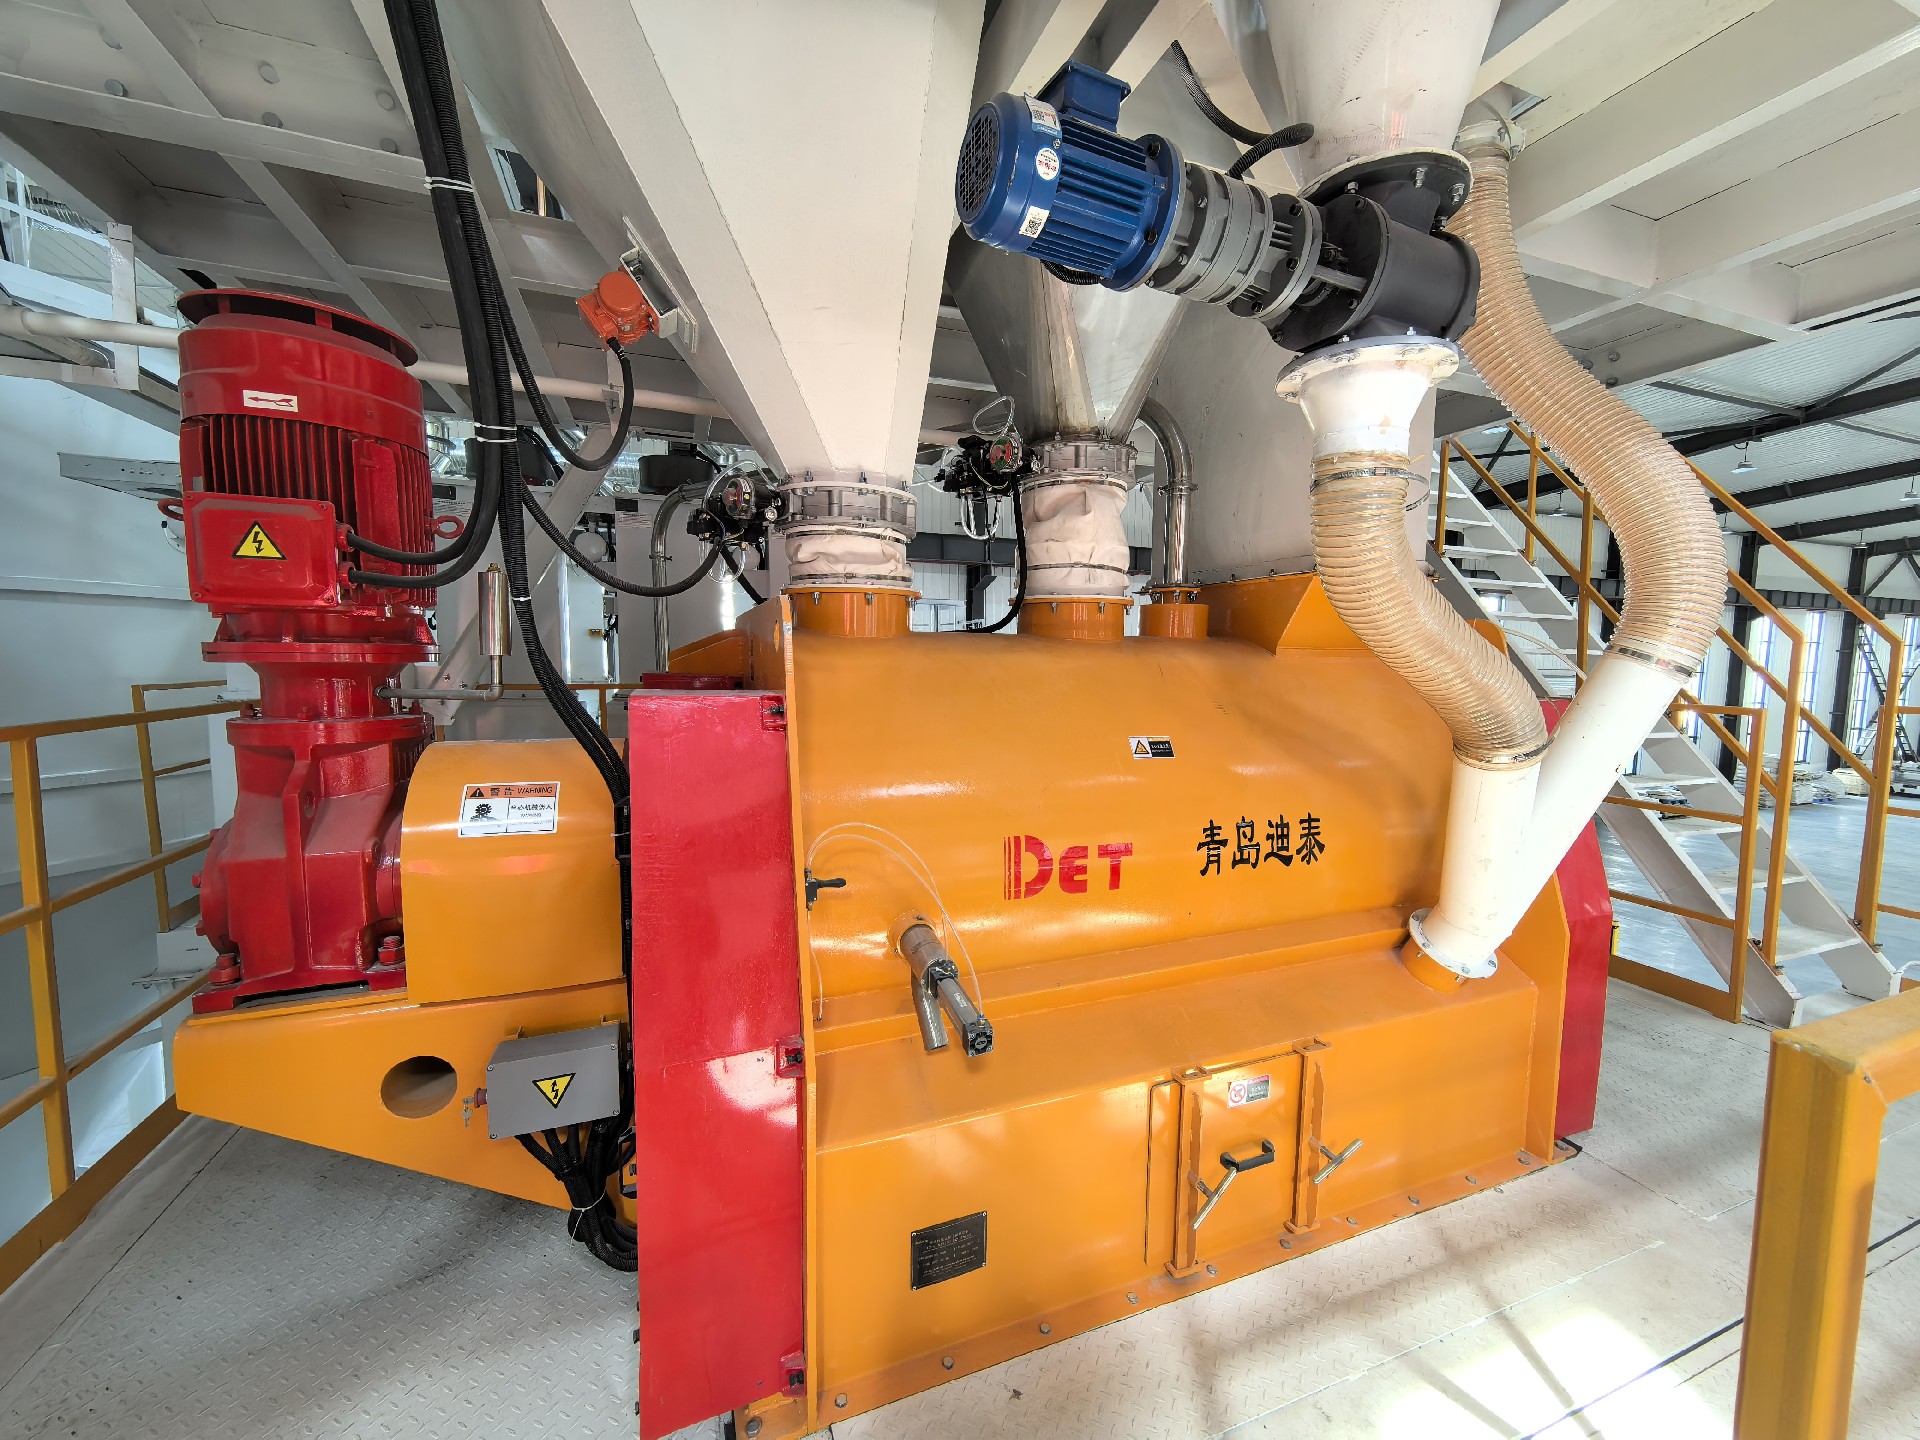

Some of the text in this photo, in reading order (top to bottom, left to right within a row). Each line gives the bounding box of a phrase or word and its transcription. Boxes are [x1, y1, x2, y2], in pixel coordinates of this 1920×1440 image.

[490, 787, 514, 796] 警告
[1004, 834, 1133, 900] DET
[1196, 811, 1326, 877] 青岛迪泰
